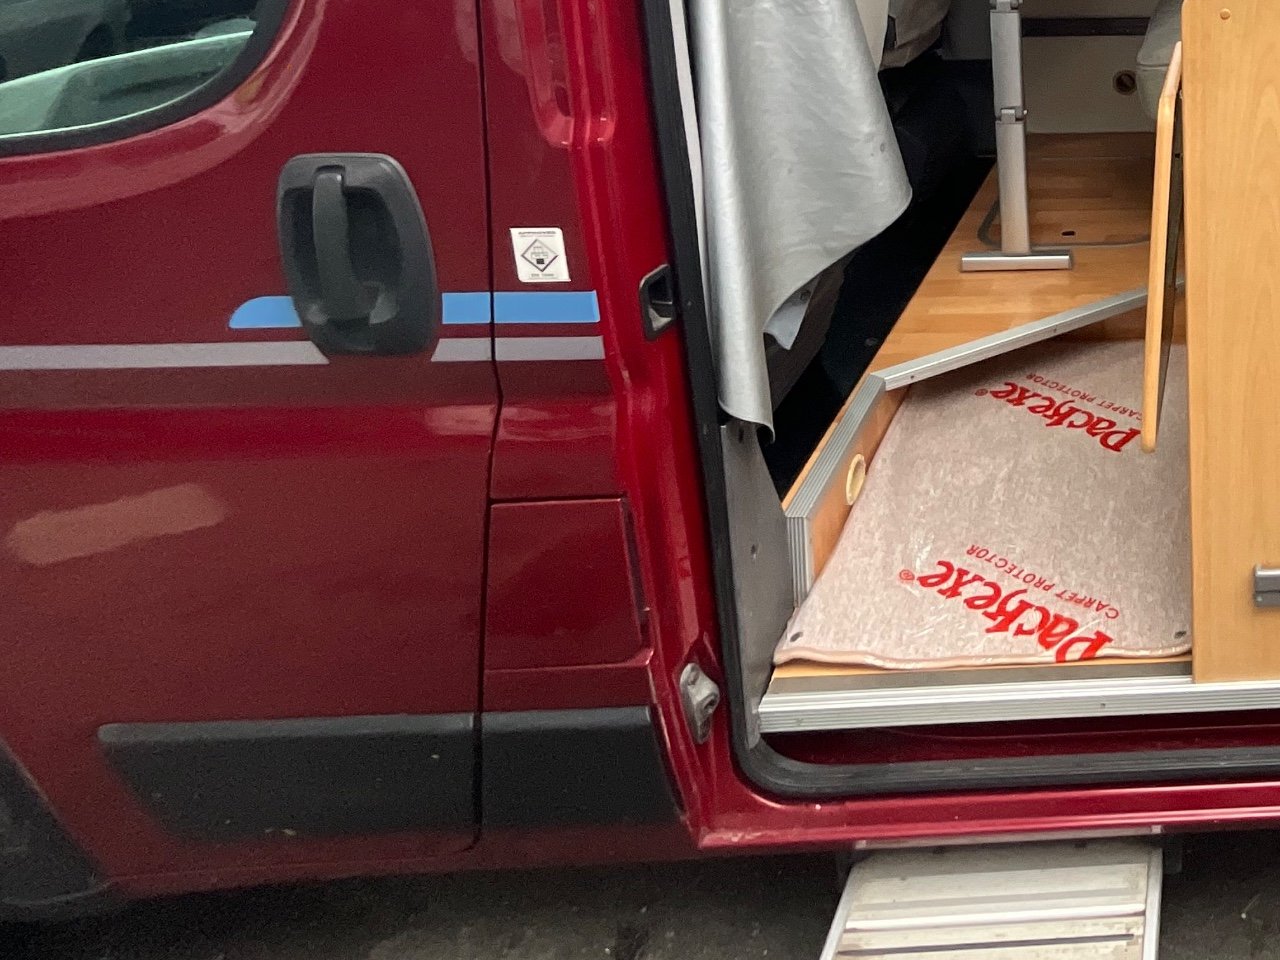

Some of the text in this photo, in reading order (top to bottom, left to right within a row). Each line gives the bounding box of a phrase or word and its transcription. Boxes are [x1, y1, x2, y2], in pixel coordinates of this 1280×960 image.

[989, 381, 1142, 453] Packexe
[1026, 372, 1095, 403] PROTECTOR
[917, 560, 1114, 664] Packexe
[966, 544, 1120, 620] CARPET PROTECTOR
